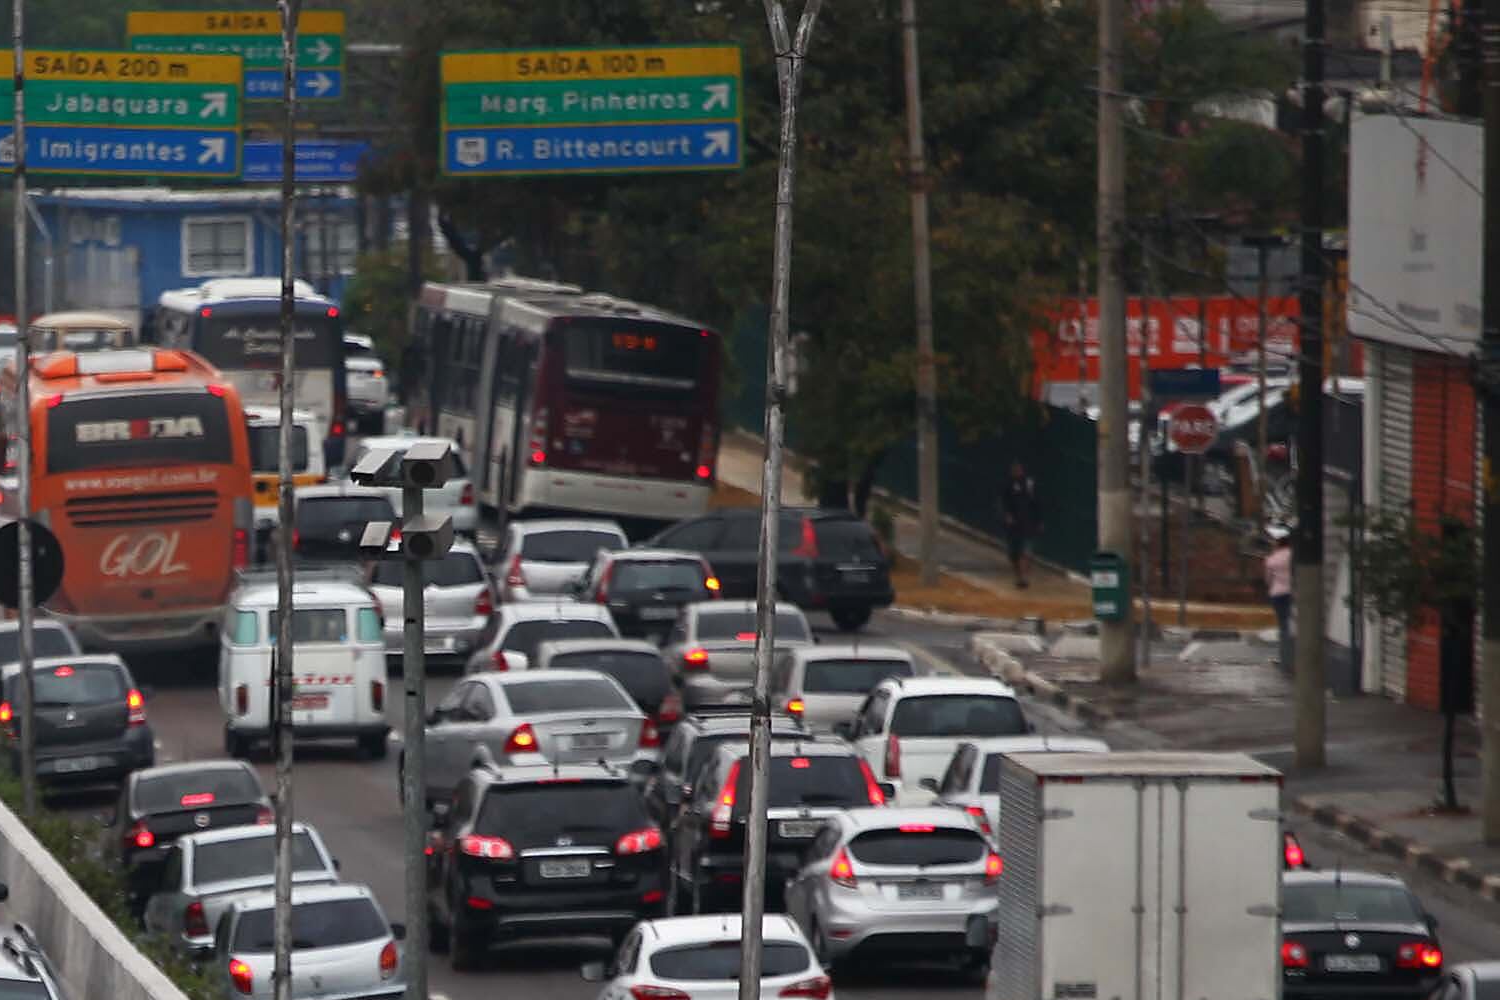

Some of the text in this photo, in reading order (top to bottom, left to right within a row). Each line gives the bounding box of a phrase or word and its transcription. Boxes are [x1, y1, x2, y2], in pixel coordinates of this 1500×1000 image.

[34, 54, 188, 77] SAÍDA 200 m
[516, 55, 666, 76] SAÍDA 100 m
[45, 93, 189, 117] Jabaquara
[481, 91, 691, 116] Marg. Pinheiros
[40, 138, 187, 162] Imigrantes
[495, 140, 525, 161] R.
[533, 136, 691, 160] Bittencourt
[101, 531, 190, 576] GOL
